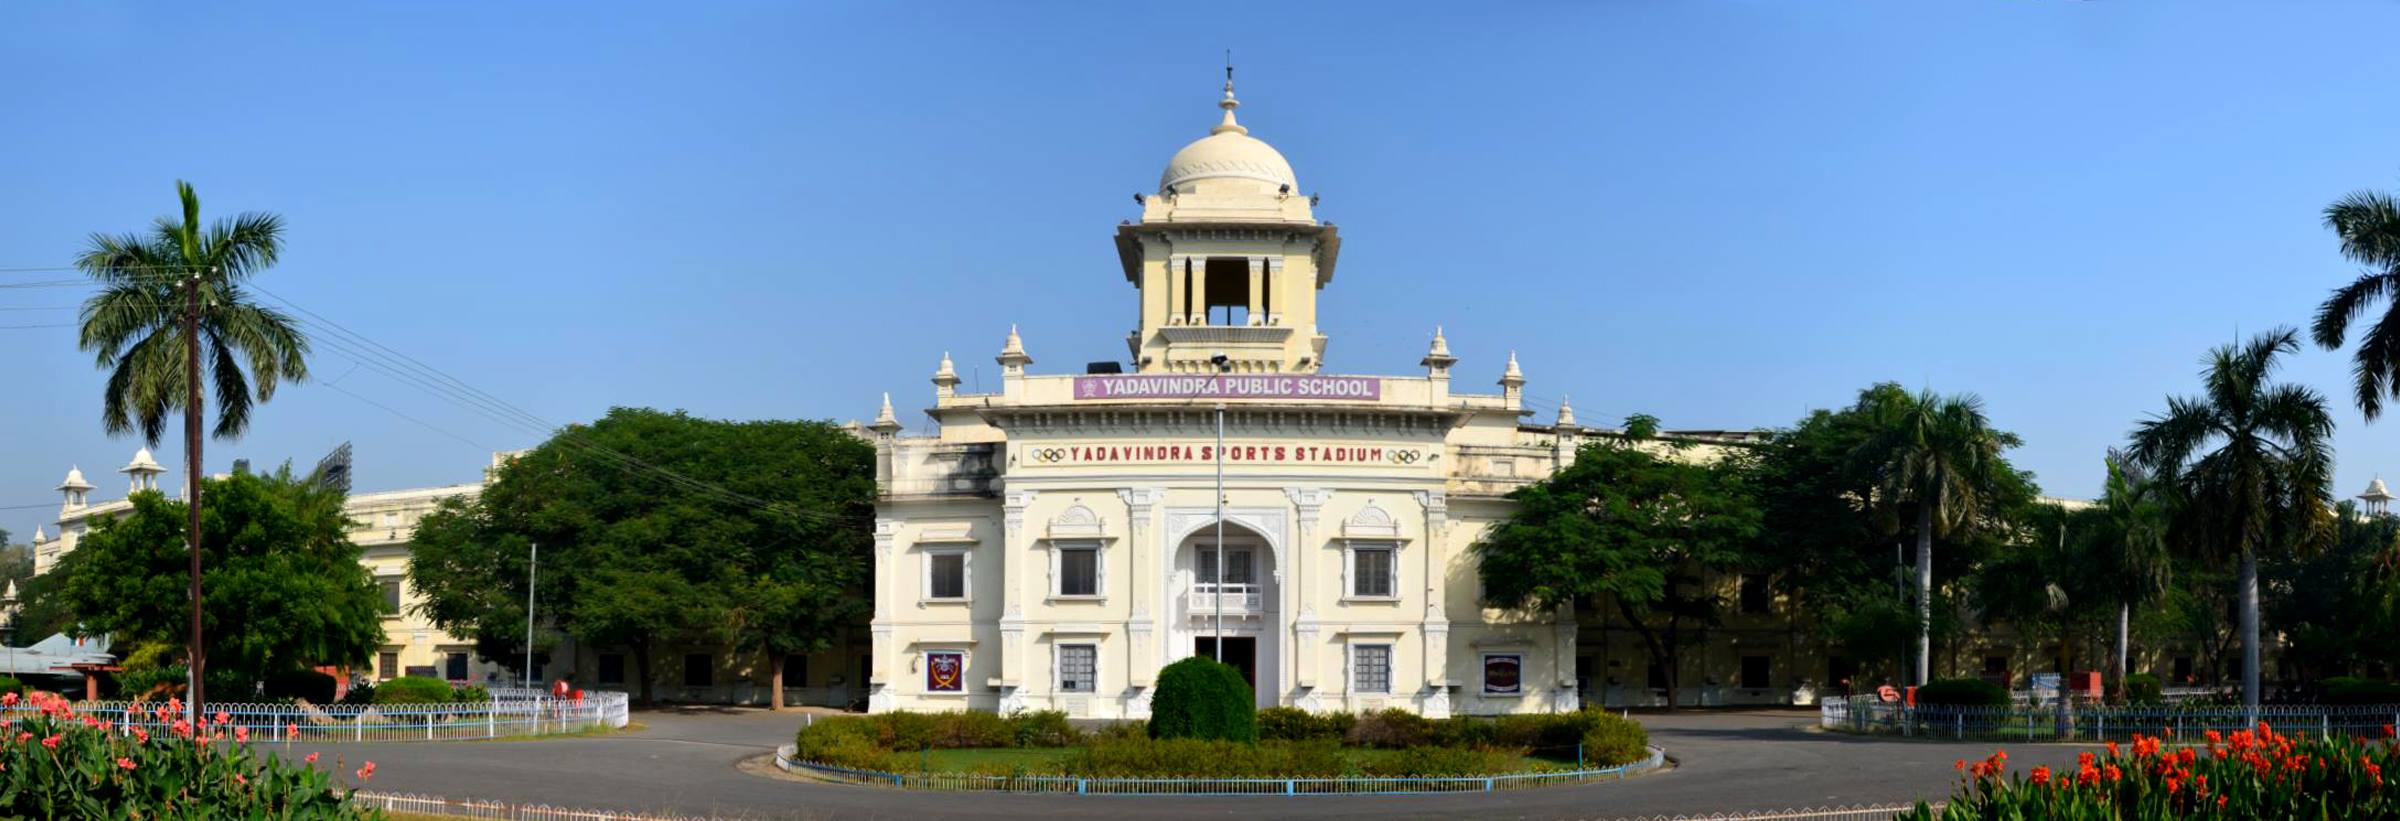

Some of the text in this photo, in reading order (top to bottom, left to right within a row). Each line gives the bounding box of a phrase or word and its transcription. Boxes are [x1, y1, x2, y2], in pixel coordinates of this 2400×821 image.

[1103, 378, 1373, 396] YADAVINDRA PUBLIC SCHOOL
[1071, 446, 1193, 461] YADAVINDRA
[1295, 447, 1381, 462] STADIUM
